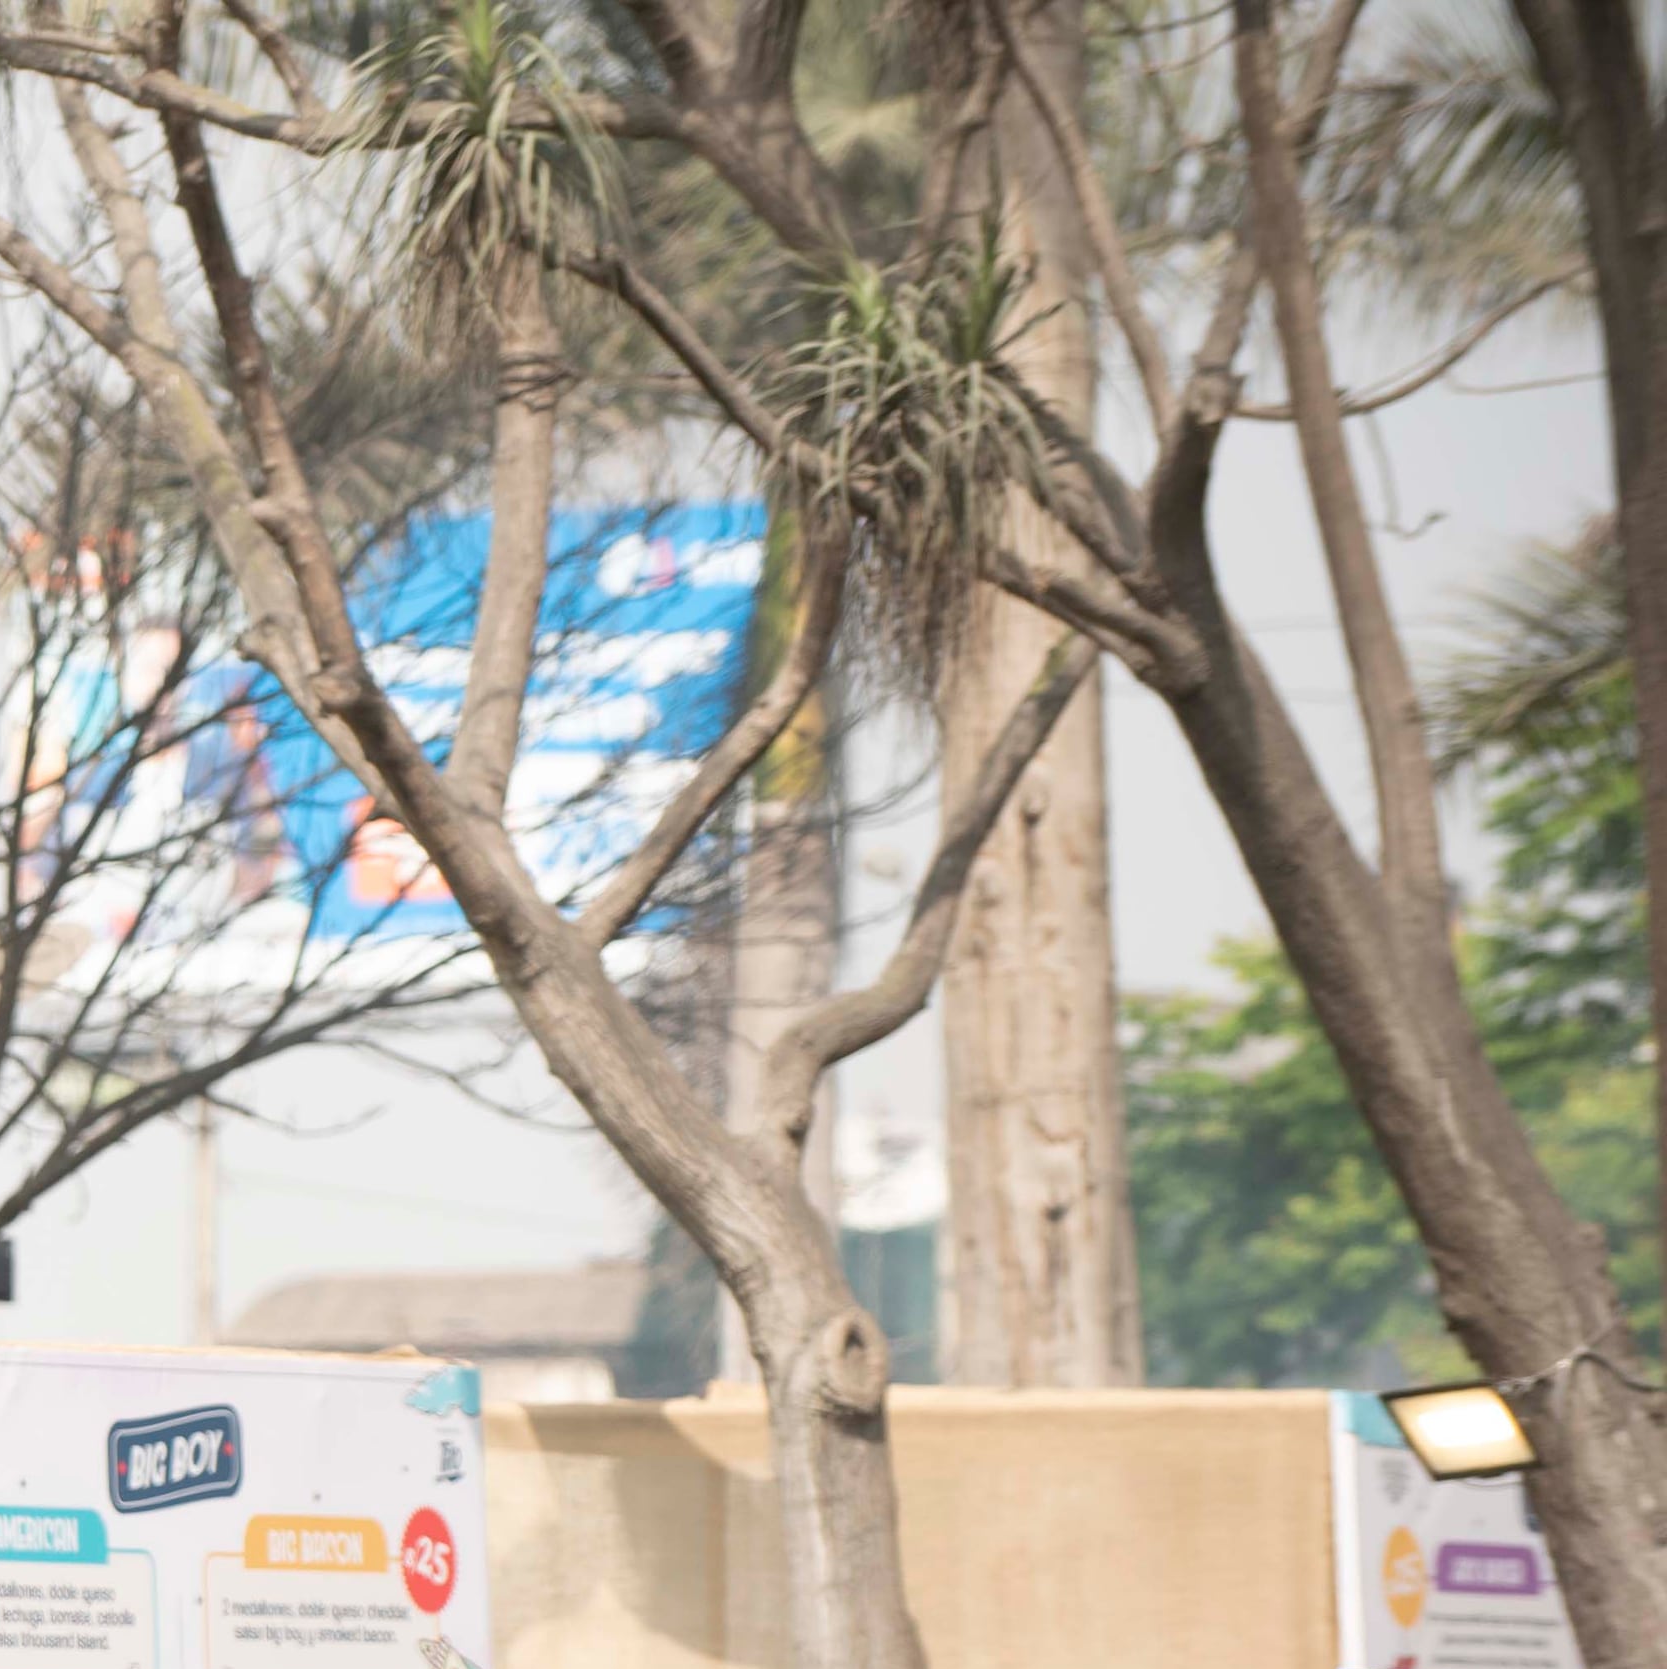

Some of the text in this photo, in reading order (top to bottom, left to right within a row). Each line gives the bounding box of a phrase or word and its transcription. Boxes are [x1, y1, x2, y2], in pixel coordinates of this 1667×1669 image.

[127, 1429, 224, 1490] BIG BOY
[268, 1529, 298, 1563] BIG
